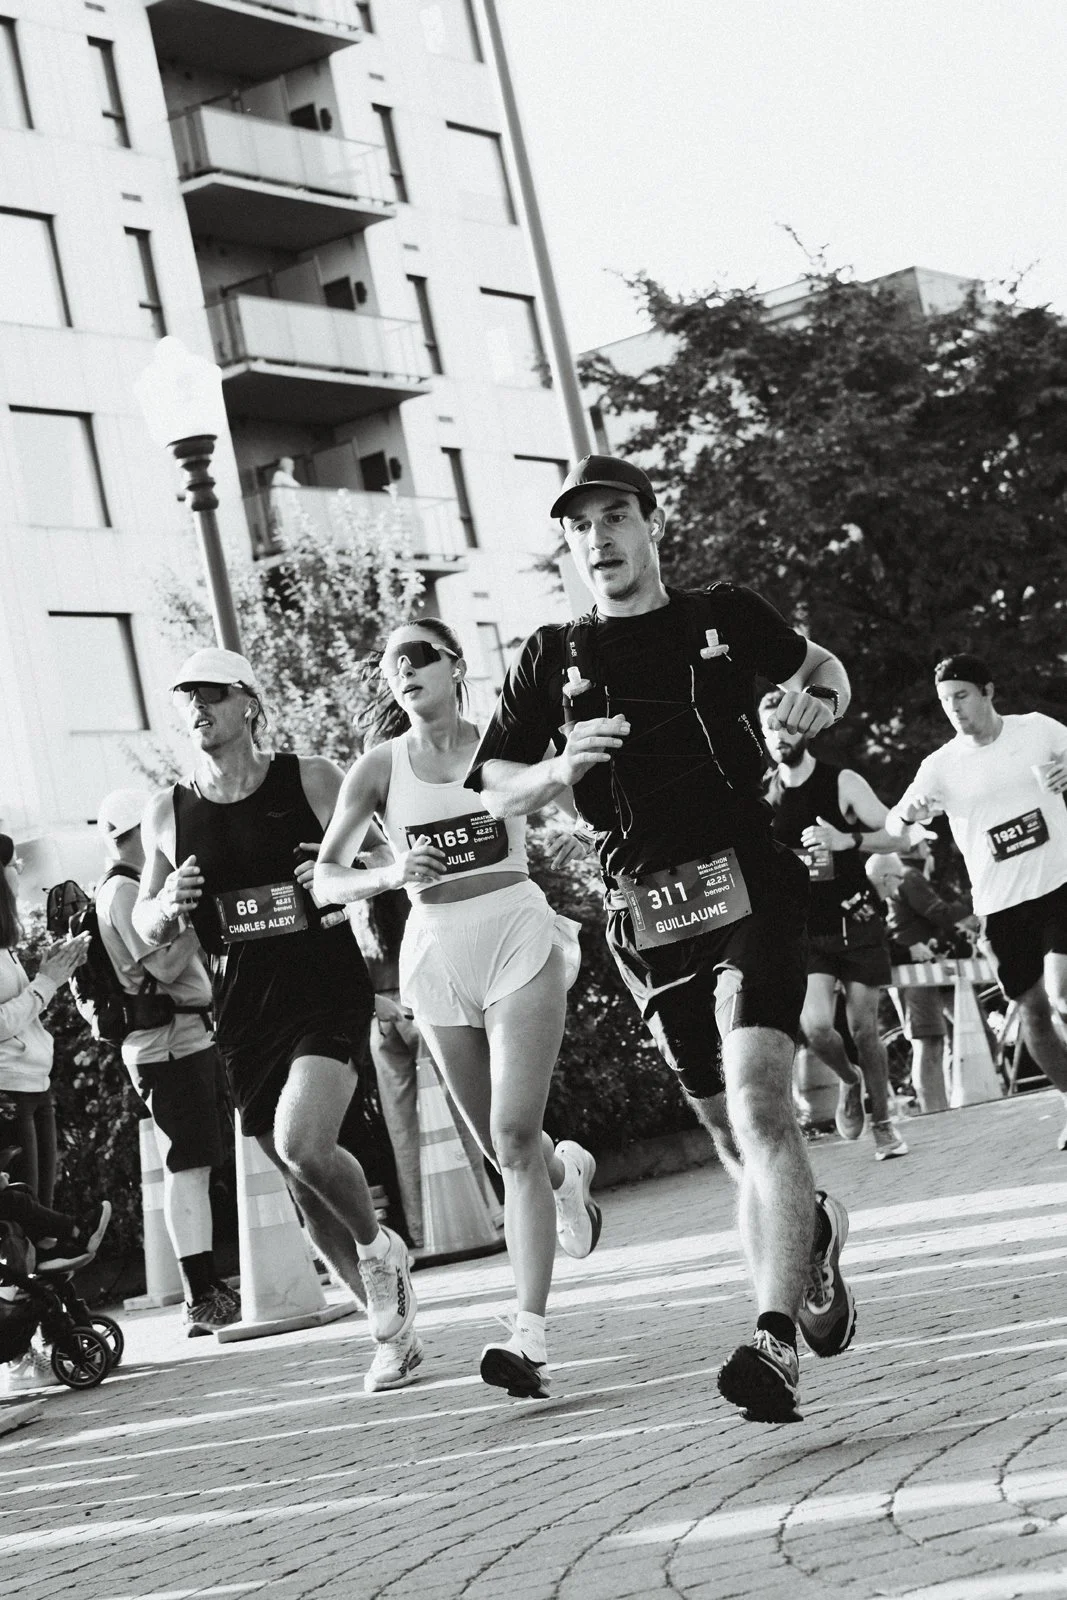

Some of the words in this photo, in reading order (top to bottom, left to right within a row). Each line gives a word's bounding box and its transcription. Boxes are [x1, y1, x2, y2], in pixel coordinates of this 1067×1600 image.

[470, 814, 493, 823] MARATHO
[993, 824, 1024, 844] 1921
[446, 851, 476, 866] JULIE
[697, 856, 728, 871] MARATHON
[647, 881, 688, 910] 311
[703, 884, 730, 897] beneva
[236, 898, 258, 916] 66
[228, 920, 266, 934] CHARLES
[268, 915, 296, 929] ALEXY
[655, 901, 728, 933] GUILLAUME
